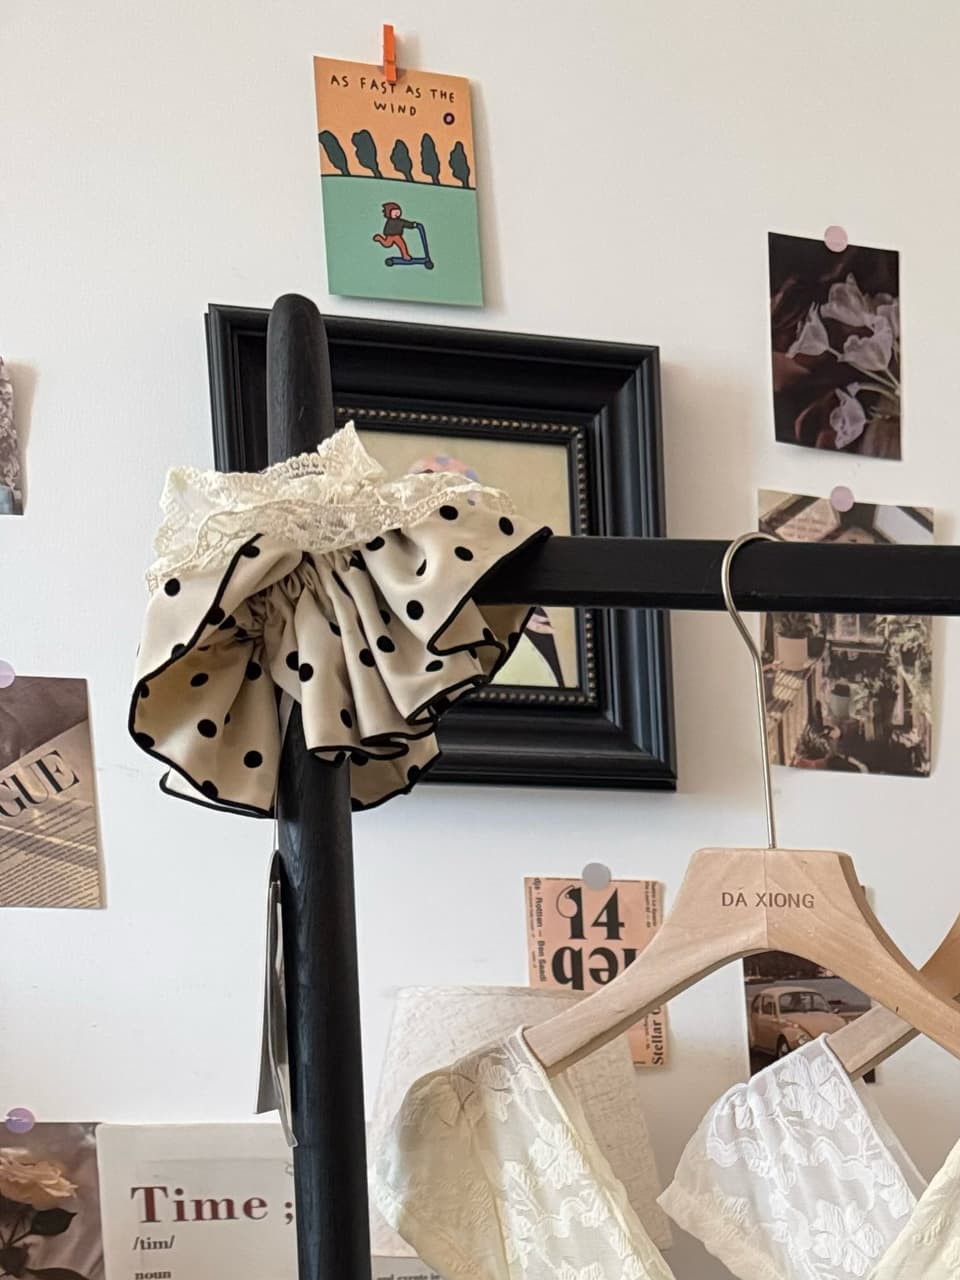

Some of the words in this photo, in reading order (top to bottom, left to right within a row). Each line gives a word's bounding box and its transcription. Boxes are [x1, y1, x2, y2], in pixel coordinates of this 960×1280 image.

[331, 75, 349, 87] AS
[360, 77, 397, 94] FAST
[405, 85, 421, 98] AS
[430, 89, 455, 103] THE
[374, 101, 417, 116] WIND
[721, 892, 747, 908] DA
[755, 892, 815, 909] XIONG
[556, 884, 625, 940] 14
[652, 1019, 664, 1066] Stellar
[130, 1186, 269, 1223] Time
[132, 1235, 175, 1250] /tim/
[135, 1271, 171, 1280] noun
